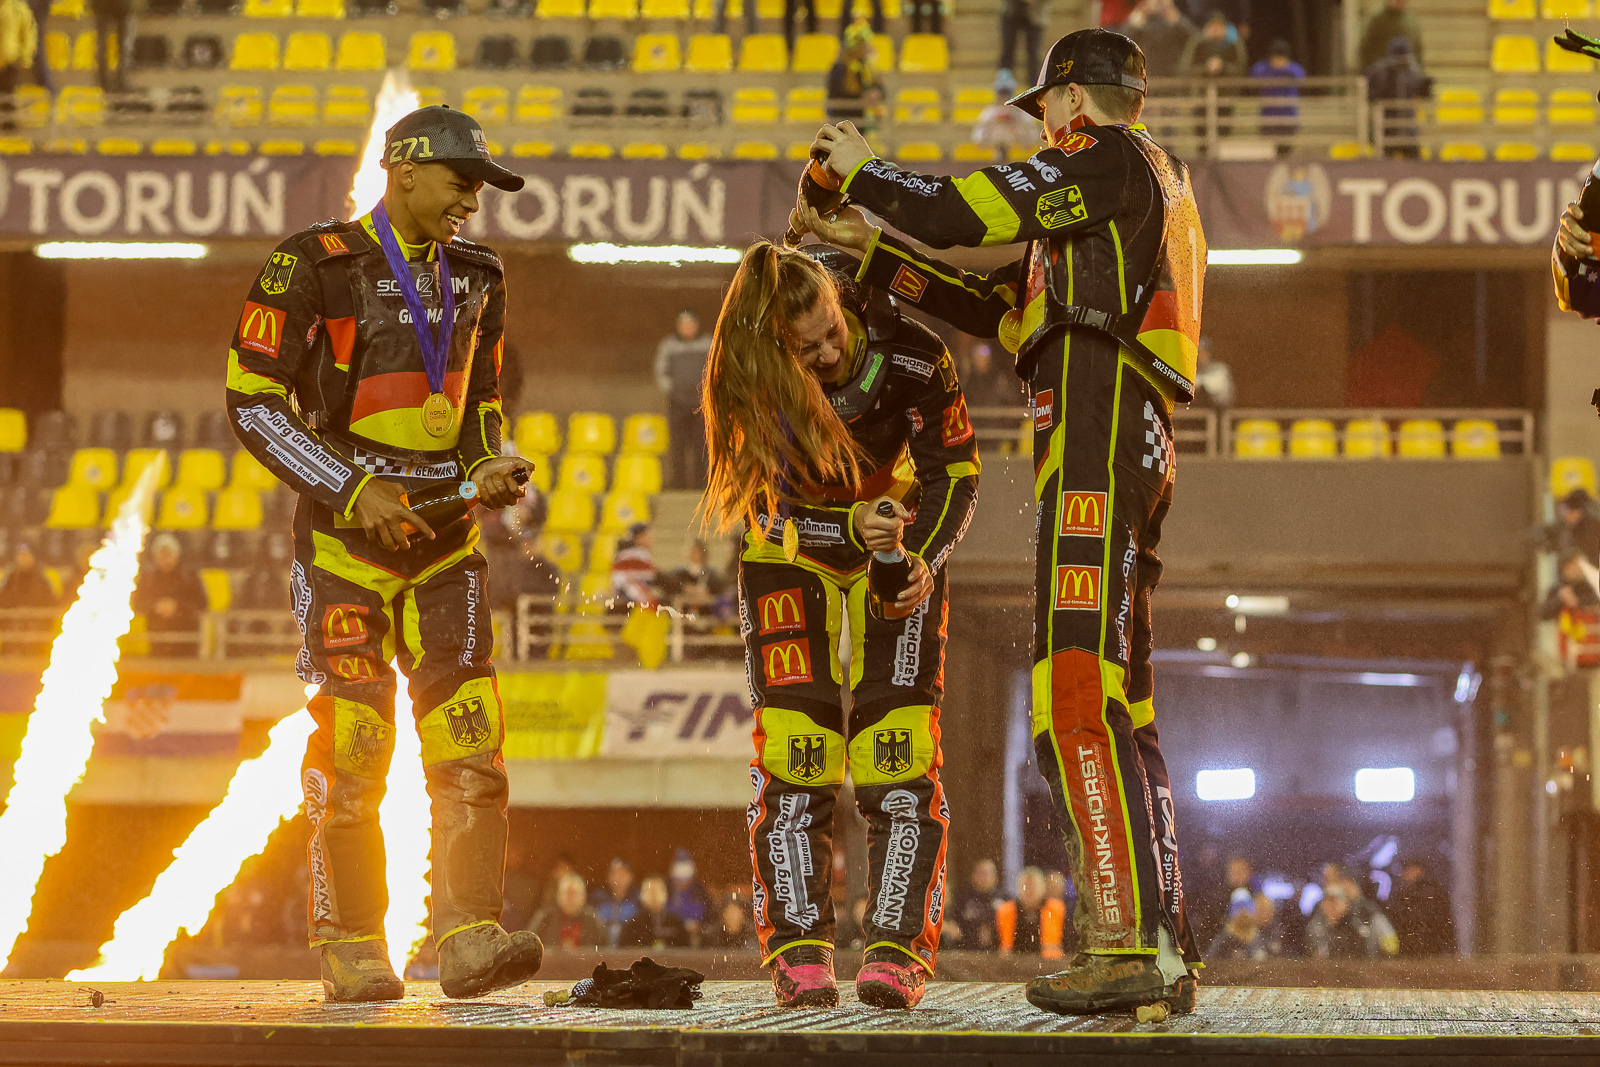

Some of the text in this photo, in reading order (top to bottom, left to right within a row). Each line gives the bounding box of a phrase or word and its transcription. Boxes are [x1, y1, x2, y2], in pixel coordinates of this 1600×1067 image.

[389, 136, 434, 163] 271
[14, 157, 286, 235] TORUŃ
[450, 276, 470, 293] IM
[398, 308, 461, 324] GEMAY
[860, 353, 885, 393] Hannah
[1152, 358, 1169, 375] 2025
[1166, 368, 1178, 381] FIM
[267, 410, 351, 479] Jörg Grohmann
[268, 444, 318, 484] Insurance Broker
[415, 464, 458, 479] GERMANY
[795, 518, 840, 534] rohmann
[886, 839, 898, 858] UND
[1078, 745, 1121, 925] BRUNKHORST
[799, 832, 811, 874] Insurance
[775, 868, 792, 903] Jörg
[1163, 852, 1174, 892] Sport
